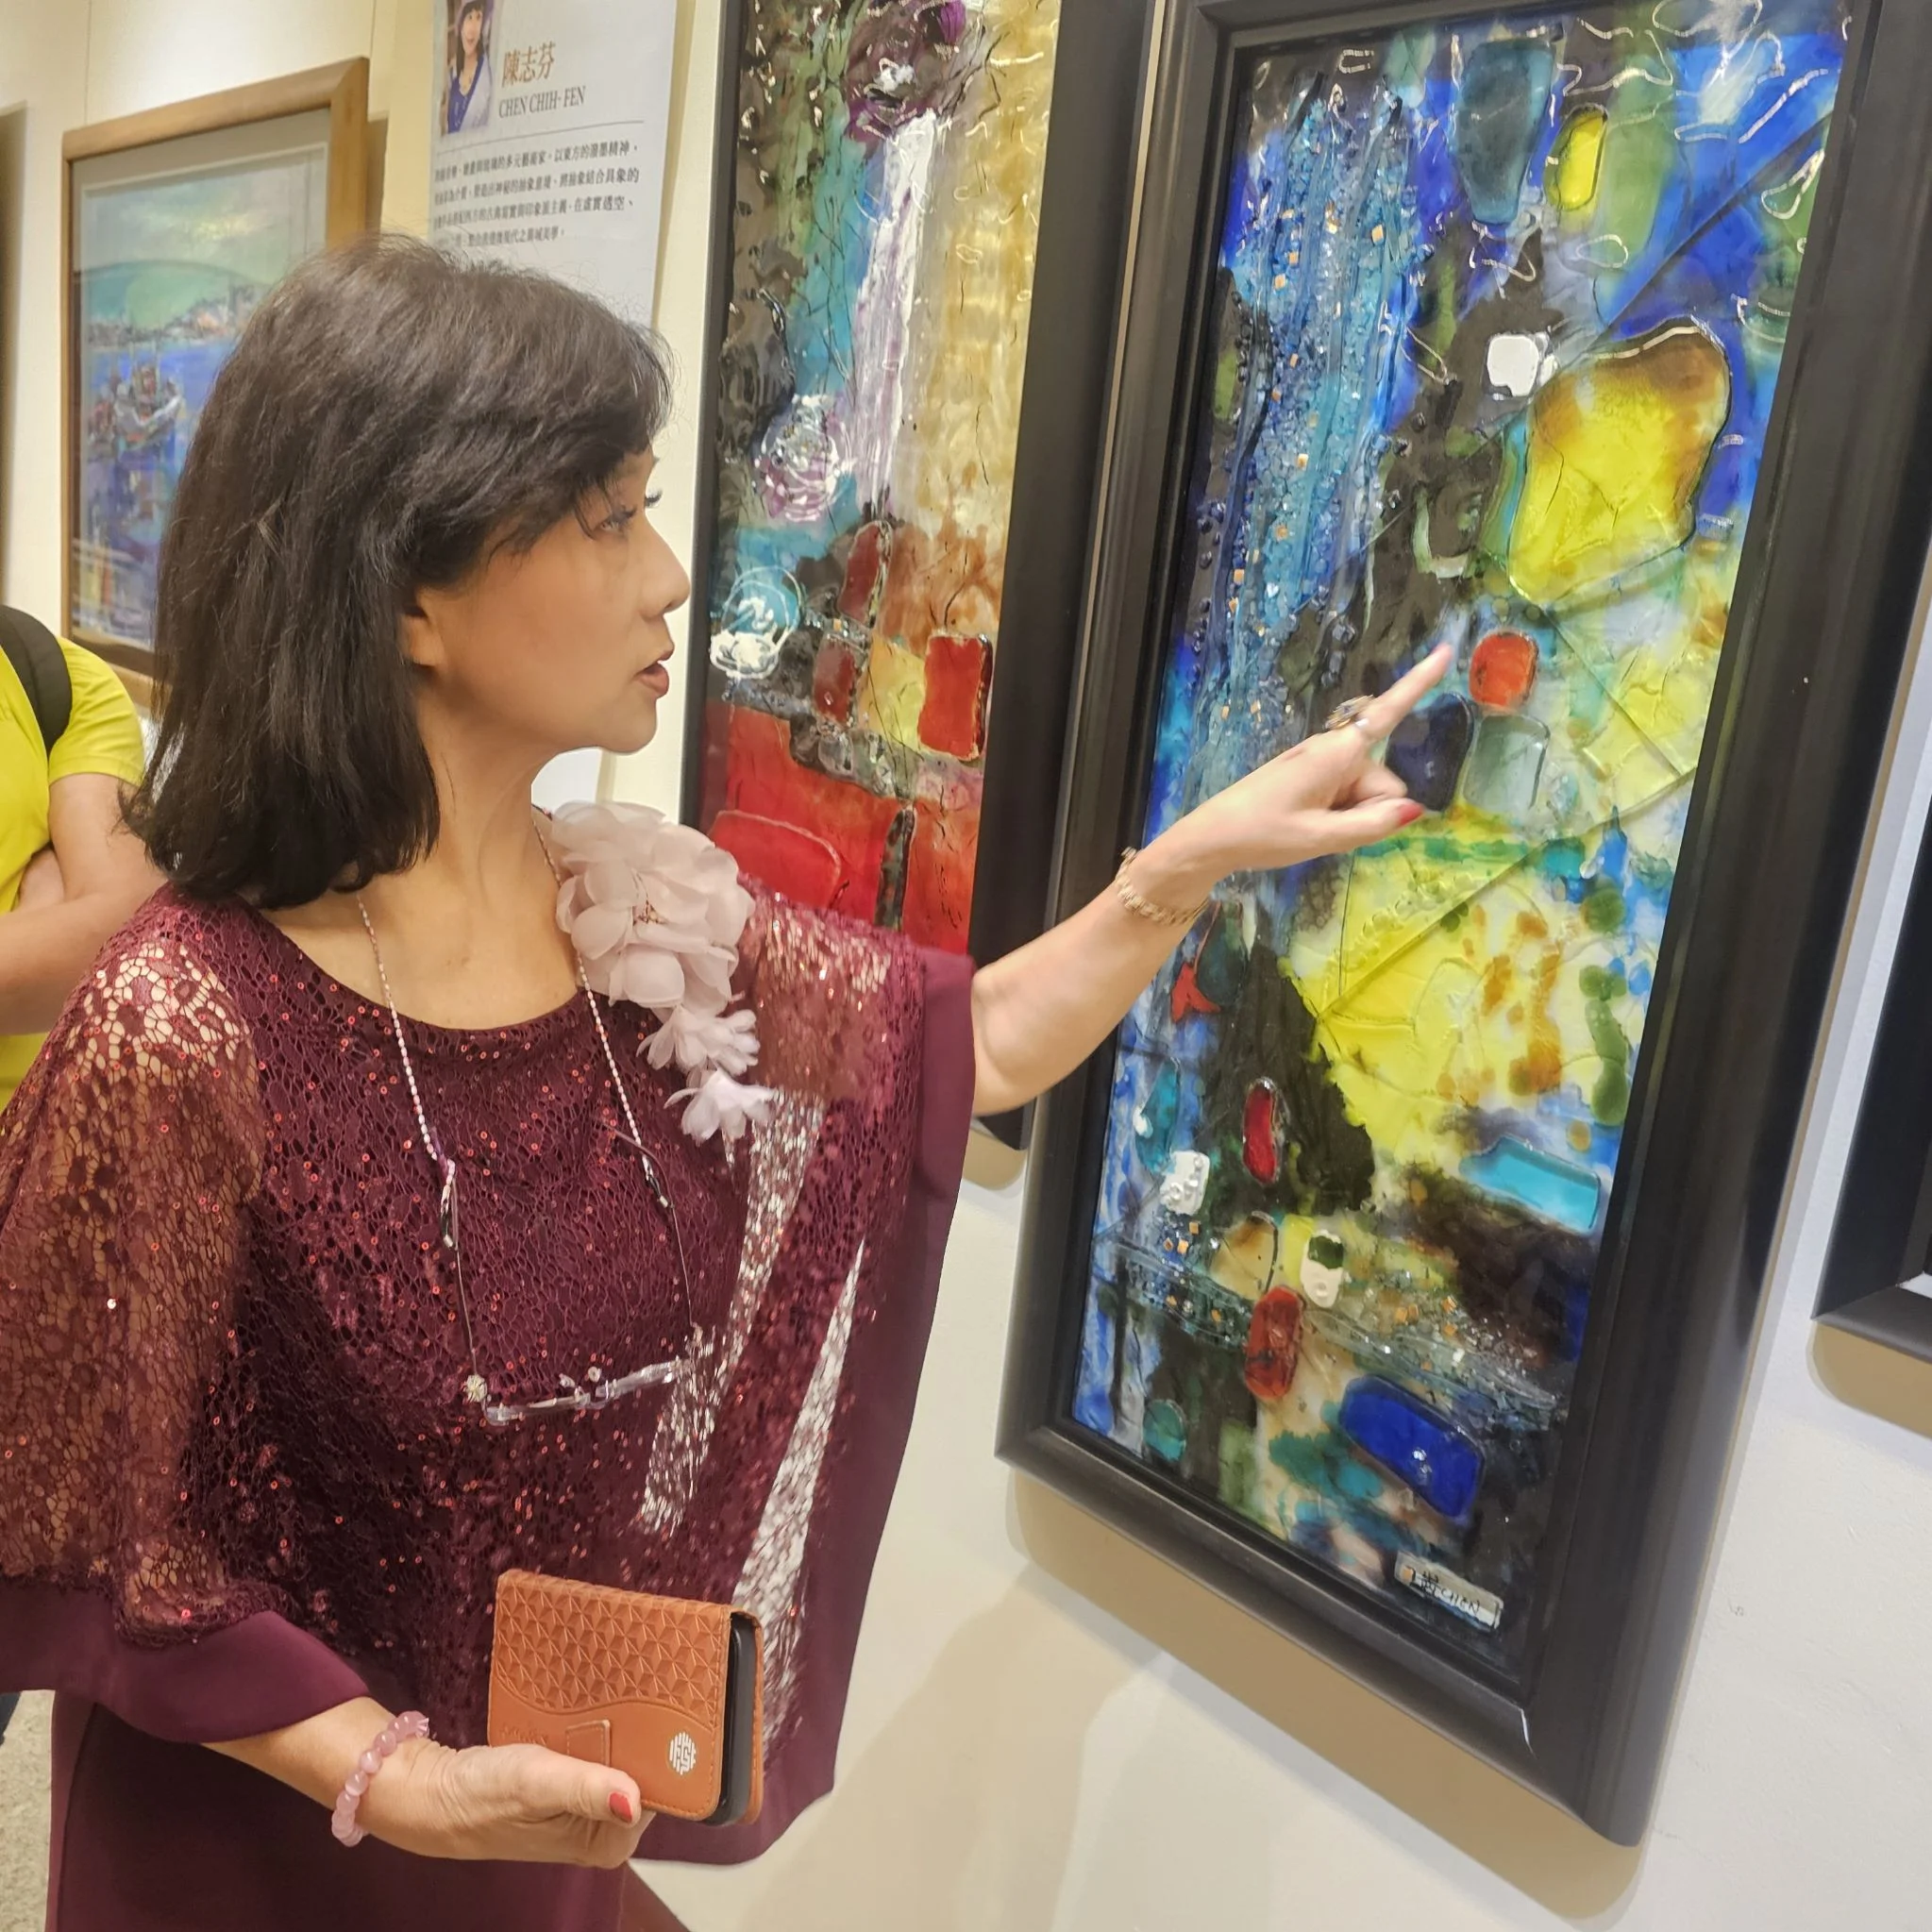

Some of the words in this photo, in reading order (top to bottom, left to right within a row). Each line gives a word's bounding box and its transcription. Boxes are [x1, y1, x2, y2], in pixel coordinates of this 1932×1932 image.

[501, 41, 556, 88] 陳志芬
[498, 97, 526, 118] CHEN
[563, 86, 586, 108] FEN
